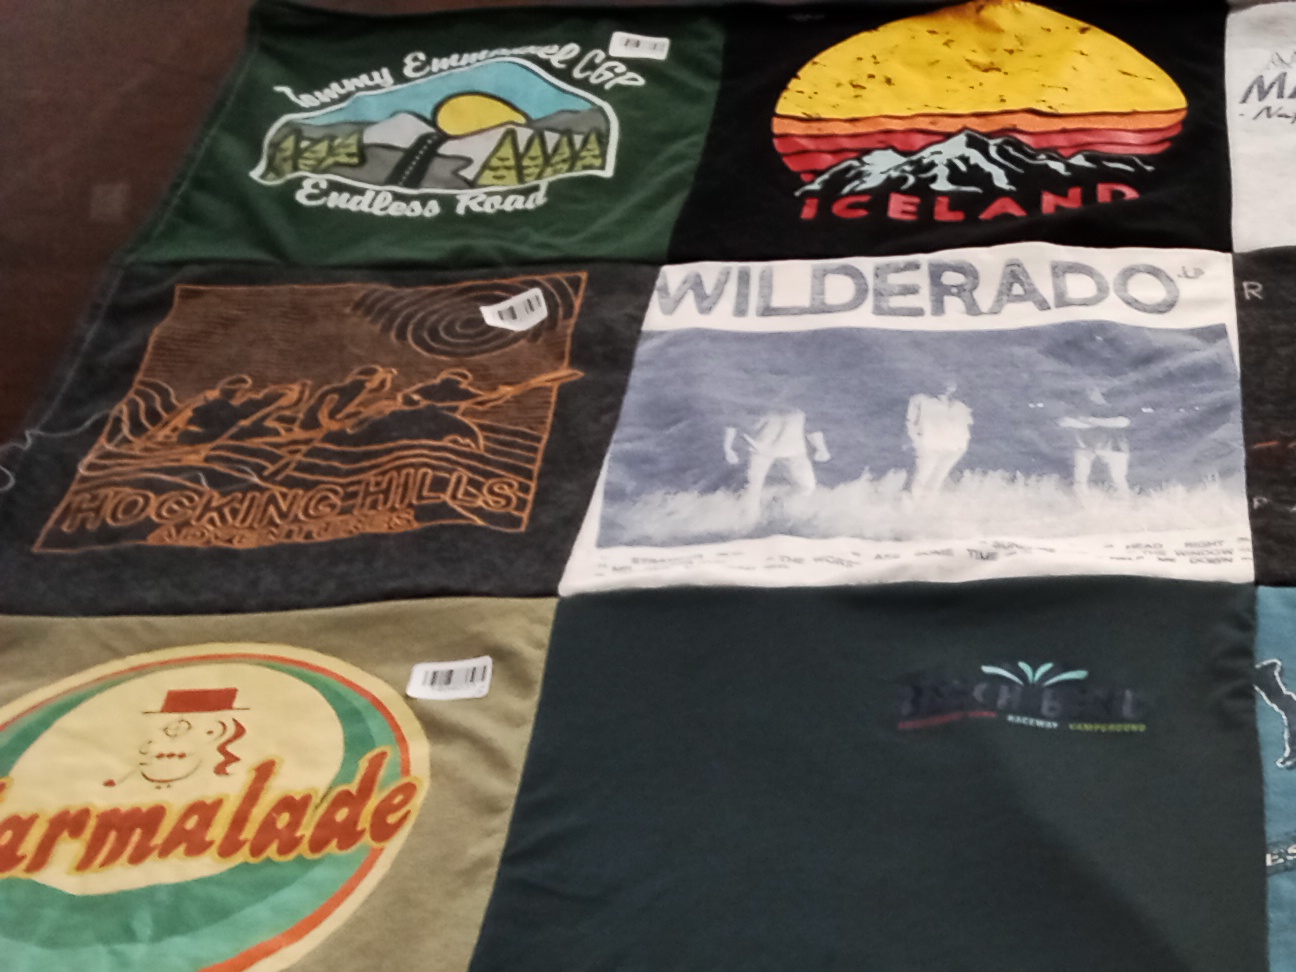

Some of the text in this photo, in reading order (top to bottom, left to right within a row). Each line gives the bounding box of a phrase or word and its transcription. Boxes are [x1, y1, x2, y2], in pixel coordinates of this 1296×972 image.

[273, 66, 395, 108] Tommy
[571, 54, 646, 91] CGP
[295, 178, 549, 218] Endless Road
[800, 182, 1141, 223] ICELAND
[655, 258, 1181, 318] WILDERADO
[62, 482, 342, 534] HOCKING
[350, 466, 521, 514] HILLS
[0, 748, 418, 874] armalade
